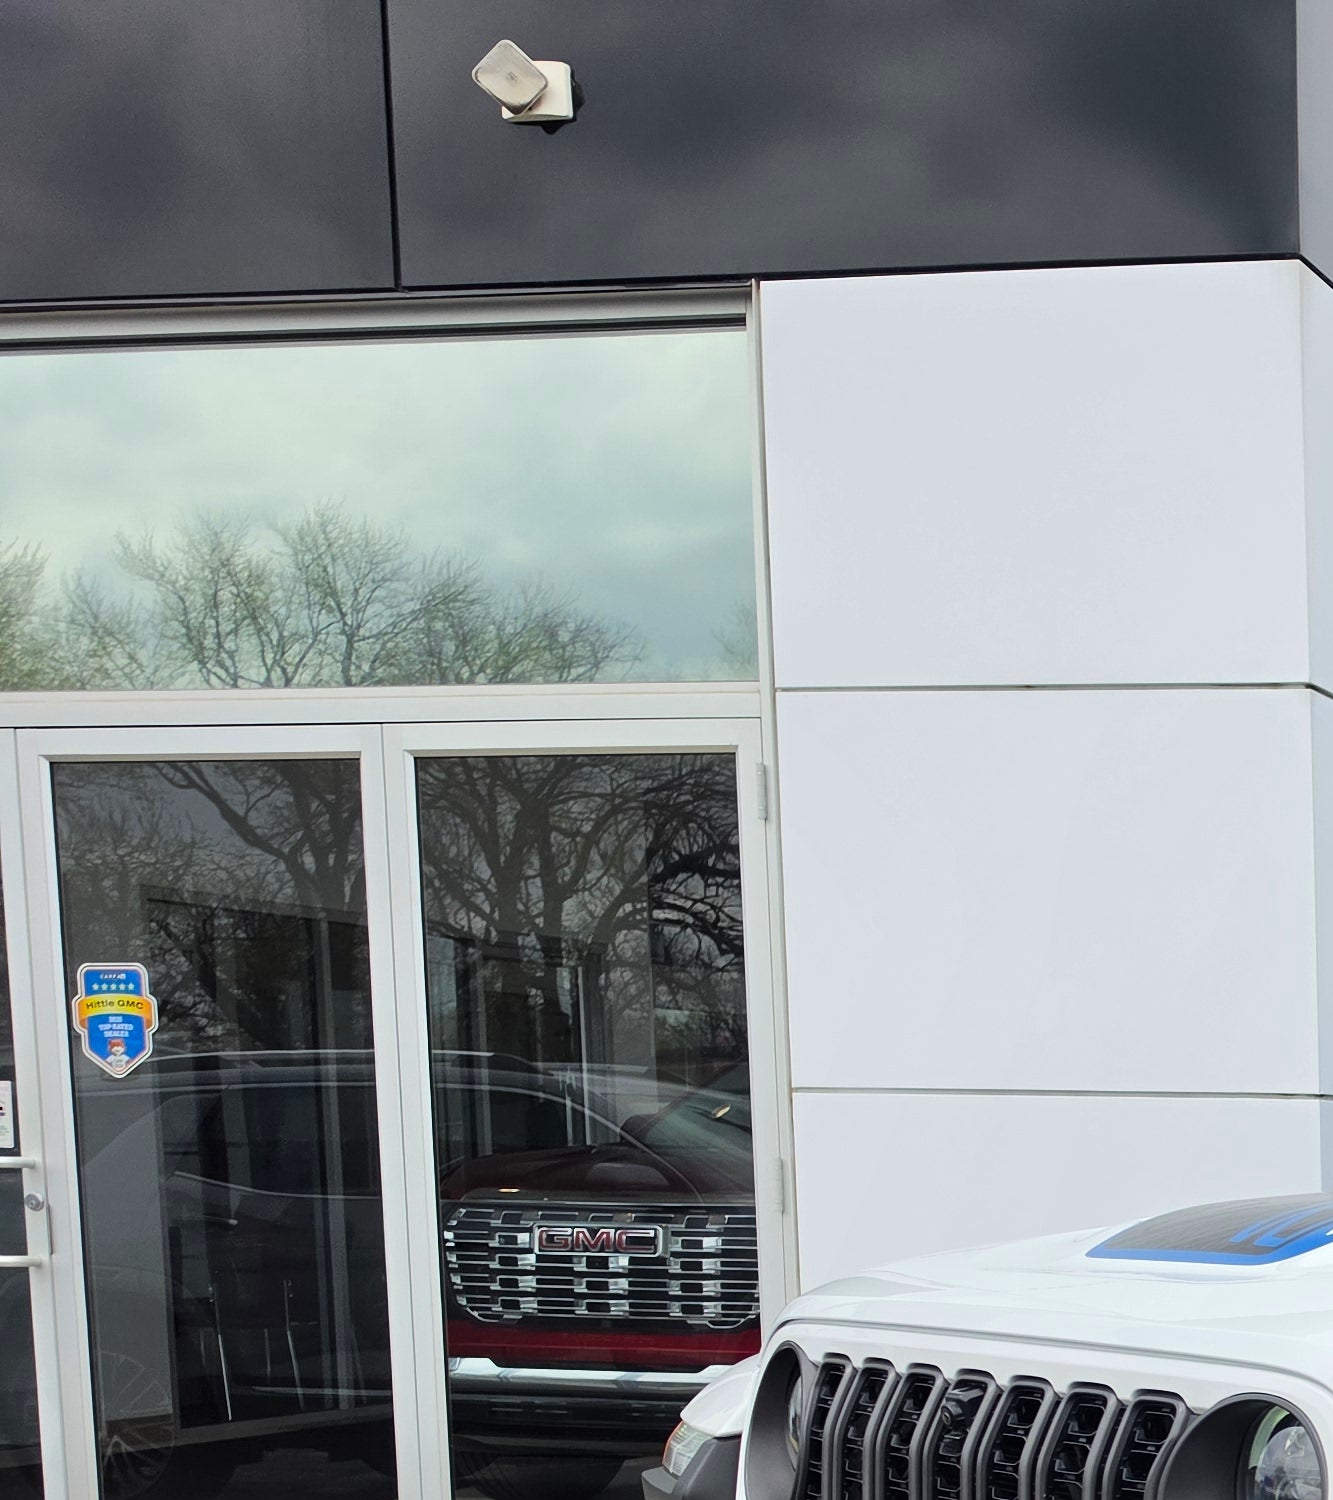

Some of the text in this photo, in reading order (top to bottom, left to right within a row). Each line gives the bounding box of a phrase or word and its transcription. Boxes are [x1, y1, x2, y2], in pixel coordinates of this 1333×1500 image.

[86, 999, 144, 1010] Hittle GMC
[538, 1227, 655, 1252] GMC
